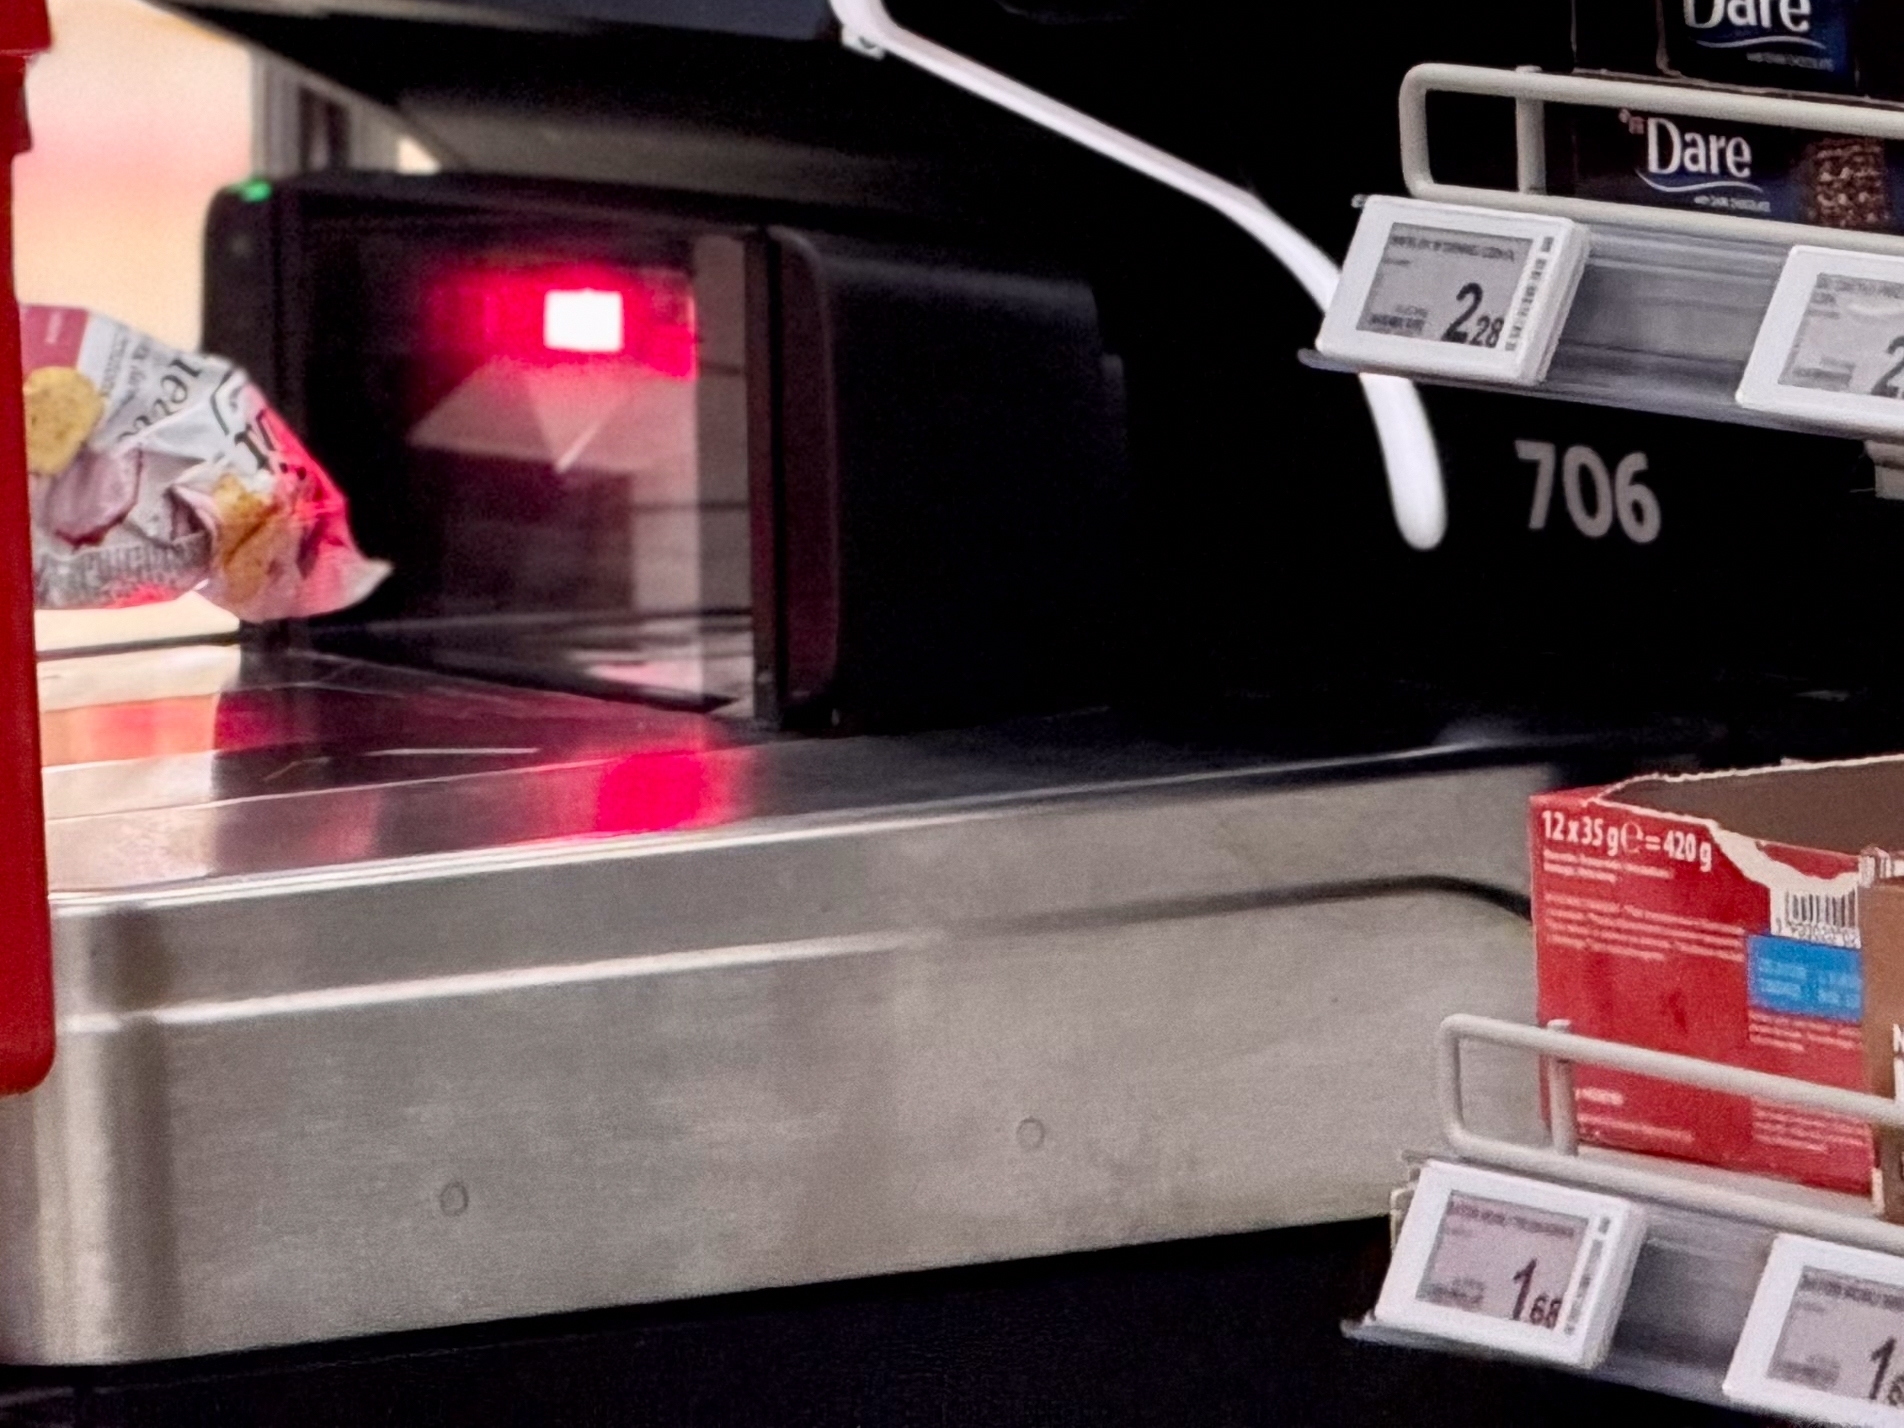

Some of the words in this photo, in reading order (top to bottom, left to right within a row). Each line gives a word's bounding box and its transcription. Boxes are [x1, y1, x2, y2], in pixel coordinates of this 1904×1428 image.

[1648, 117, 1752, 178] Dare
[1514, 438, 1661, 544] 706
[1663, 830, 1697, 863] 420
